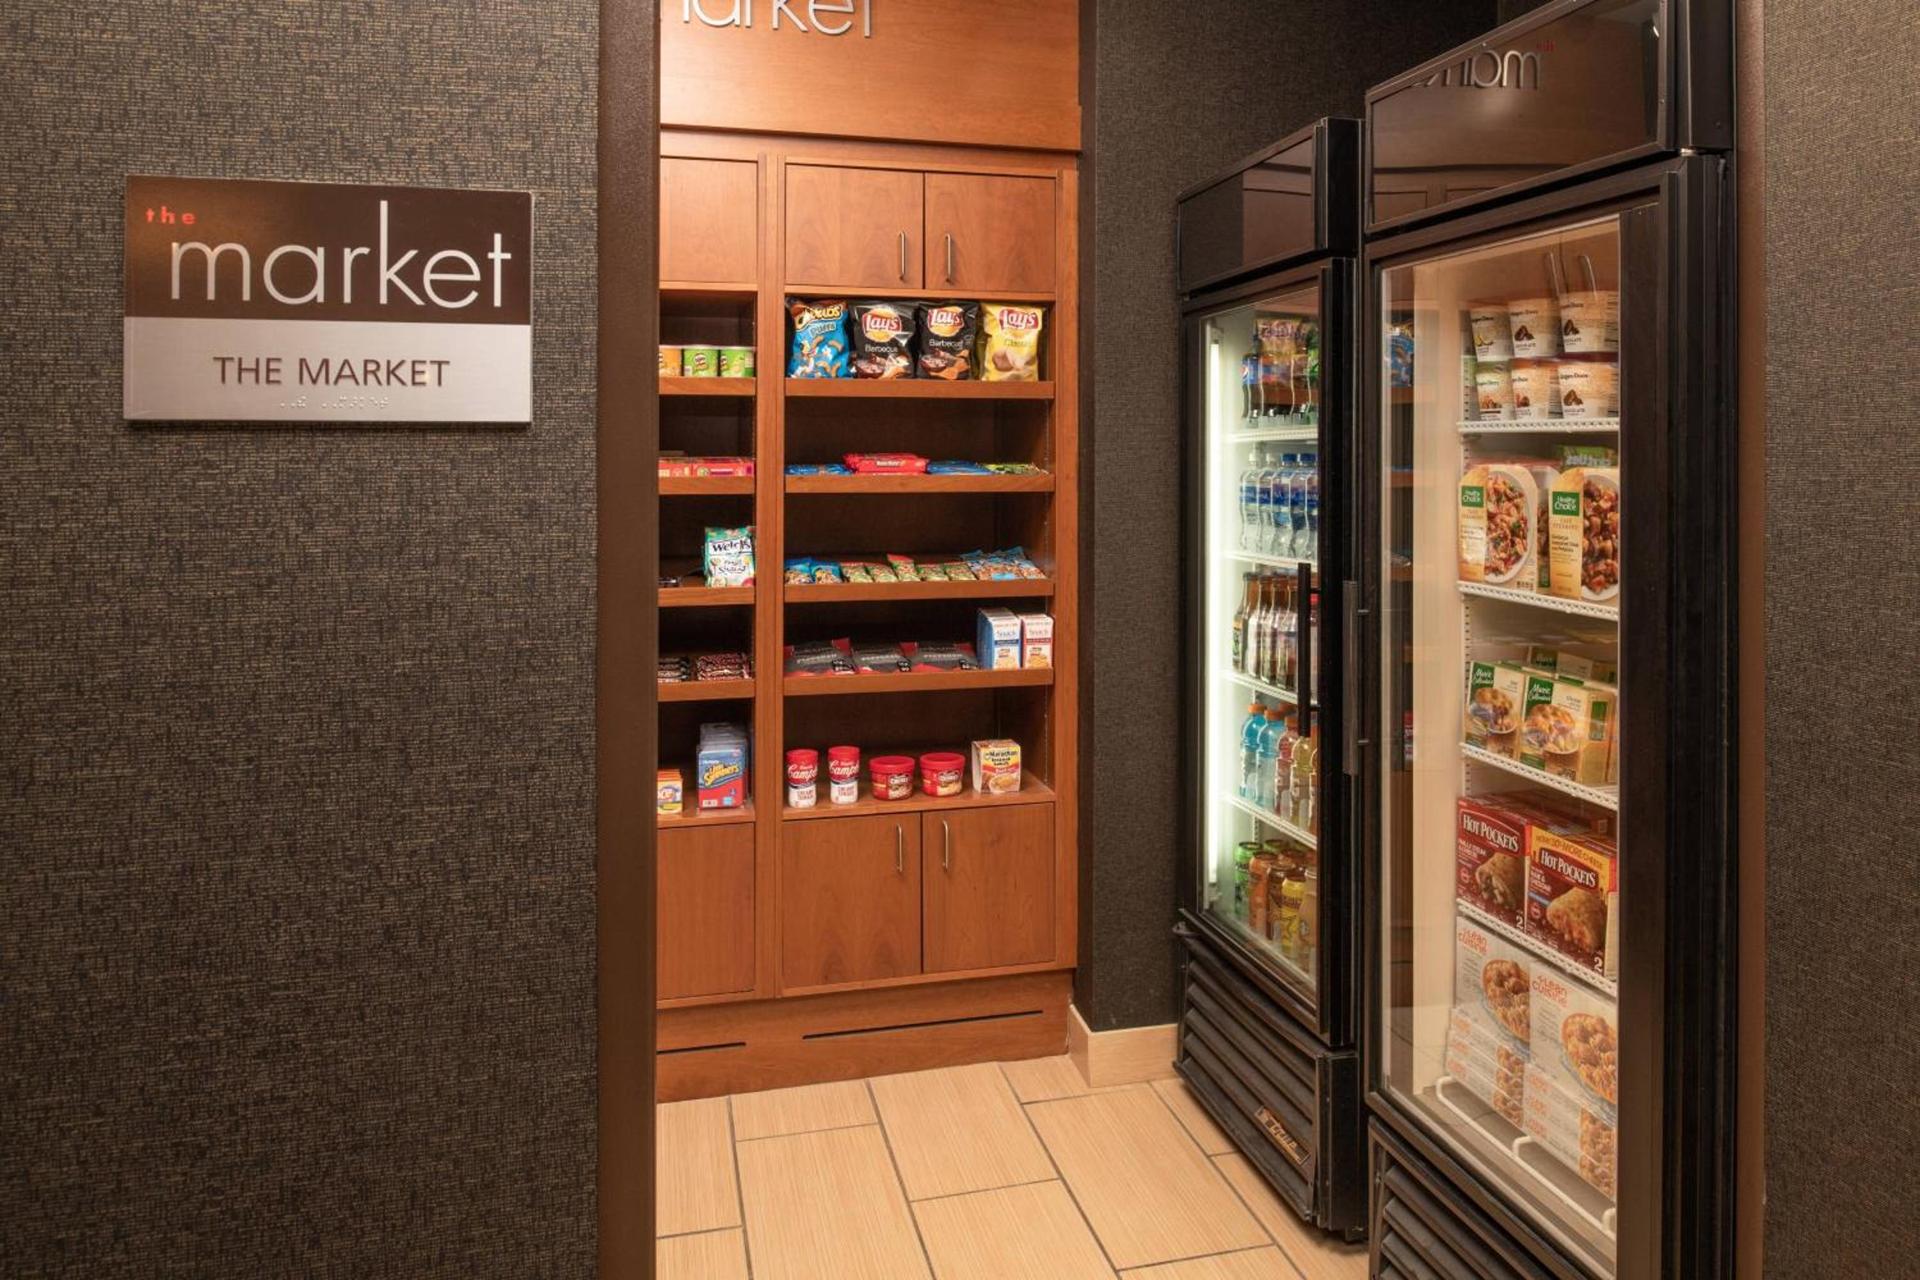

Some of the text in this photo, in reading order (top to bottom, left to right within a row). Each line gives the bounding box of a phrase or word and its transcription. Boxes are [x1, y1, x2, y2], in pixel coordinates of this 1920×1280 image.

[145, 206, 196, 225] the
[171, 200, 512, 309] market
[1001, 310, 1037, 329] Lay's
[213, 357, 451, 387] THE MARKET
[1463, 814, 1480, 836] HOT
[1480, 821, 1519, 853] POCKETS
[1541, 850, 1596, 887] HOT POCKETS
[1515, 916, 1524, 930] 2
[1594, 957, 1603, 973] 2
